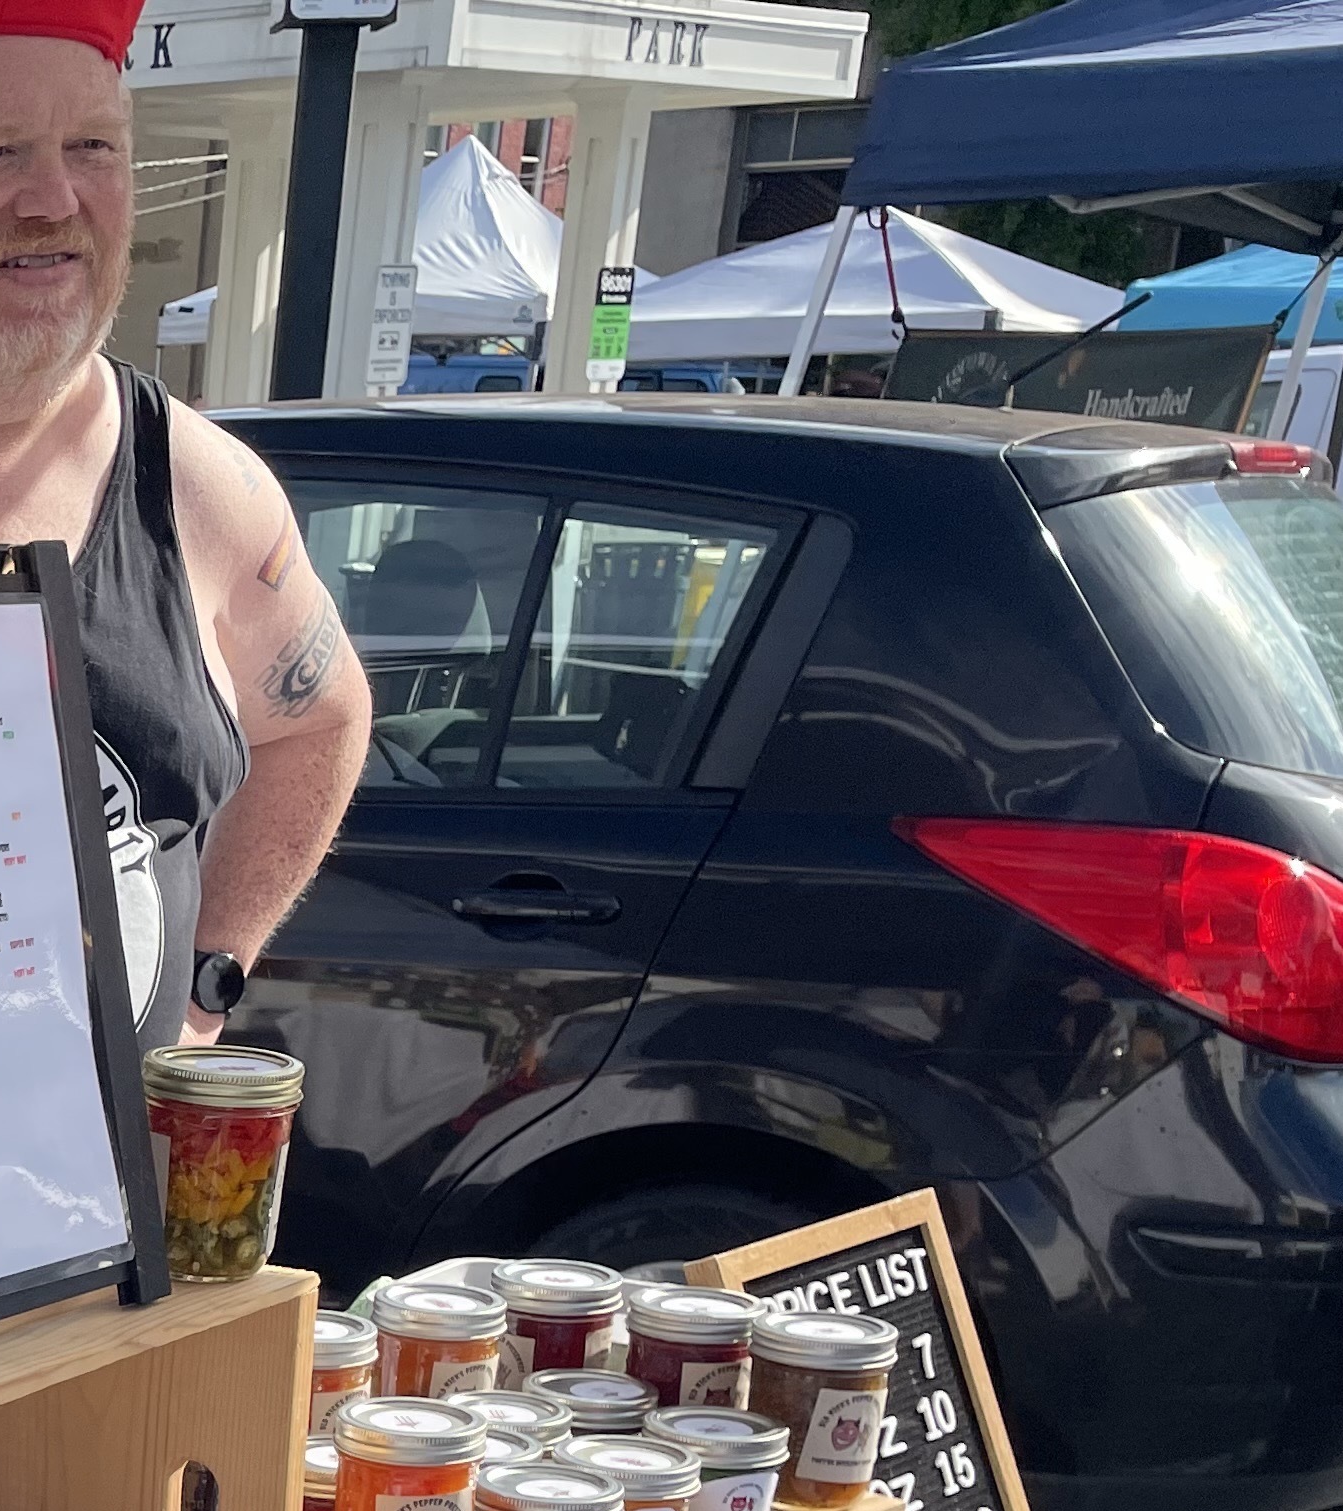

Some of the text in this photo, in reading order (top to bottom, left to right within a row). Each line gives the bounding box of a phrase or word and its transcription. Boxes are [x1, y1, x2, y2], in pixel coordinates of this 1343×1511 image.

[626, 17, 709, 67] PARK
[1083, 386, 1194, 419] Handcrafted
[858, 1248, 930, 1308] LIST
[912, 1333, 935, 1379] 7
[916, 1390, 957, 1442] 10
[935, 1442, 975, 1497] 15
